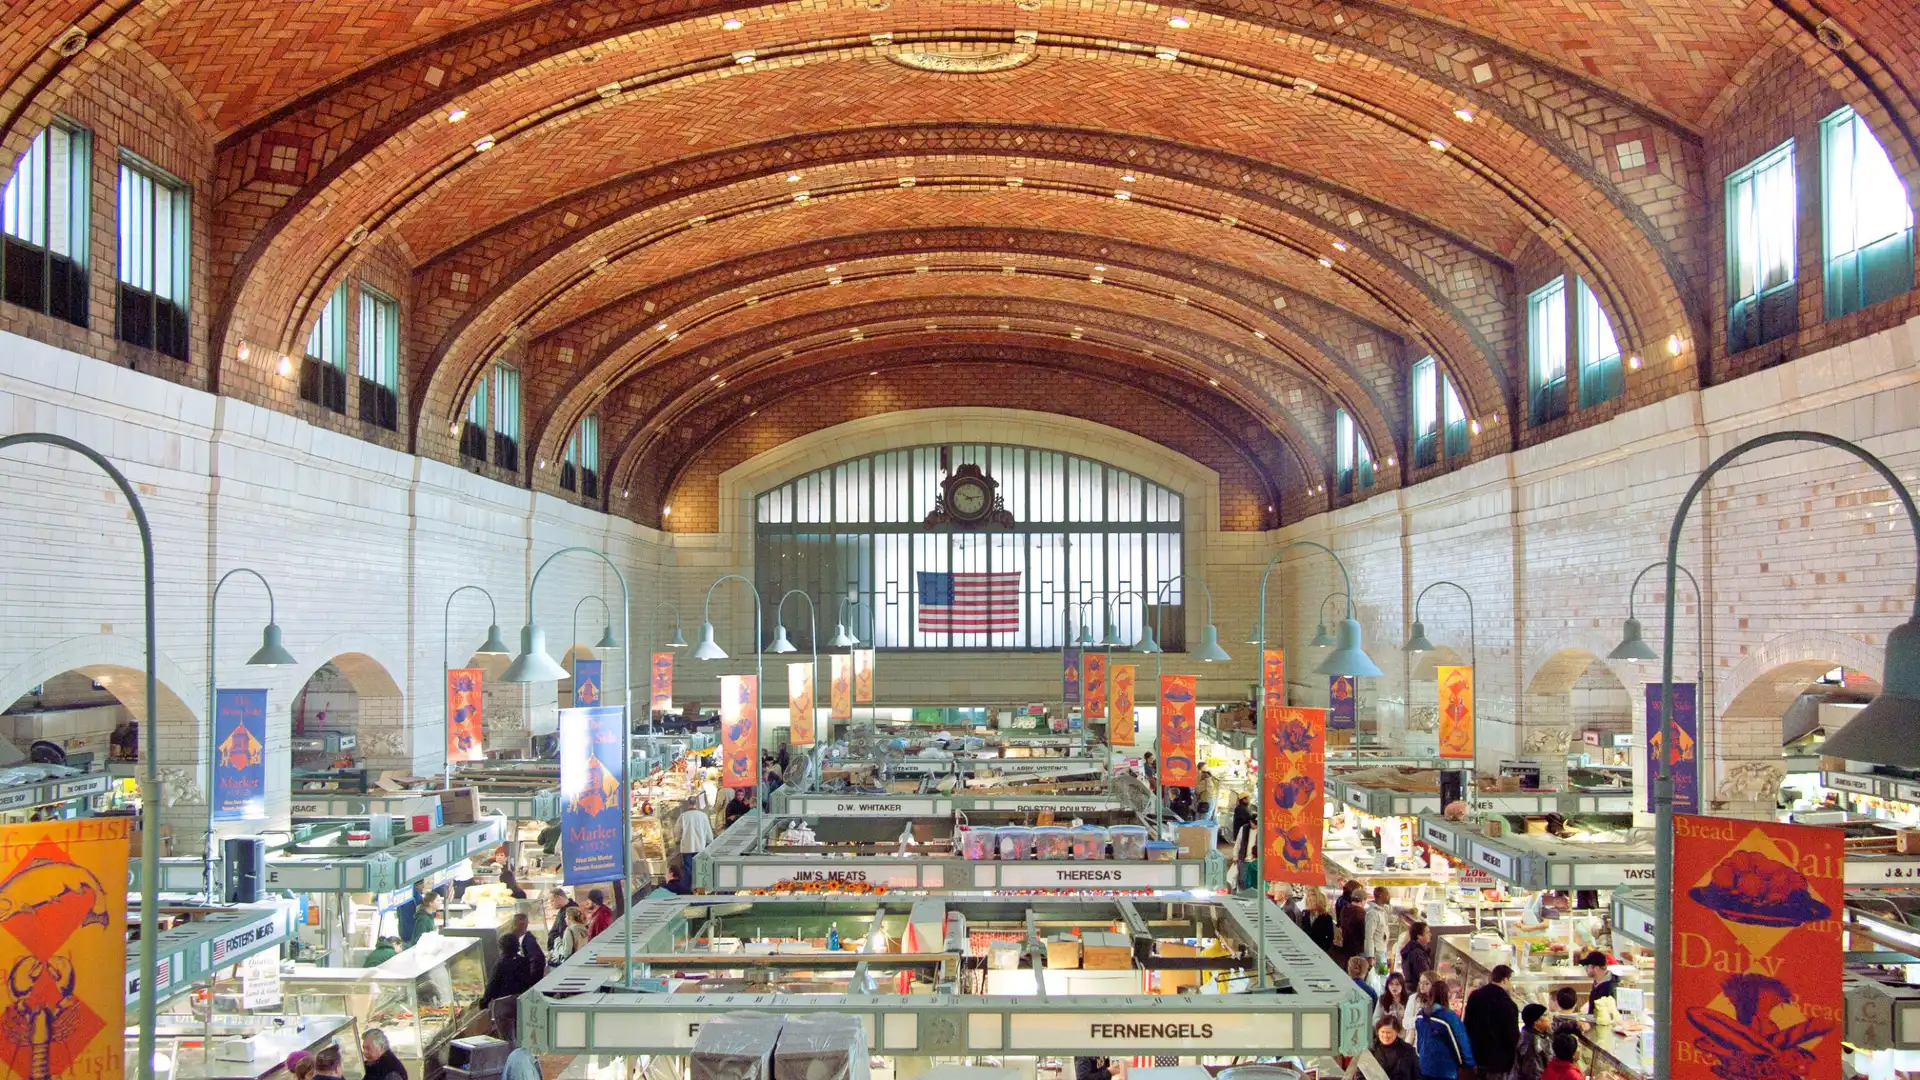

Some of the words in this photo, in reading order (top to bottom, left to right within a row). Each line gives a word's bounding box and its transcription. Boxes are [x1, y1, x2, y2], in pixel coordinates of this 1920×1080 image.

[569, 826, 617, 843] Market
[1676, 815, 1736, 841] Bread
[793, 871, 823, 881] JIM'S
[828, 871, 866, 881] MEATS
[1056, 870, 1121, 880] THERESA'S
[1465, 869, 1487, 877] LOW
[1885, 868, 1891, 877] J
[1894, 868, 1903, 877] &
[1906, 868, 1912, 877] J
[256, 922, 274, 940] MEATS
[1678, 932, 1785, 978] Dairy
[1350, 1008, 1360, 1024] D
[1091, 1024, 1213, 1038] FERNENGELS
